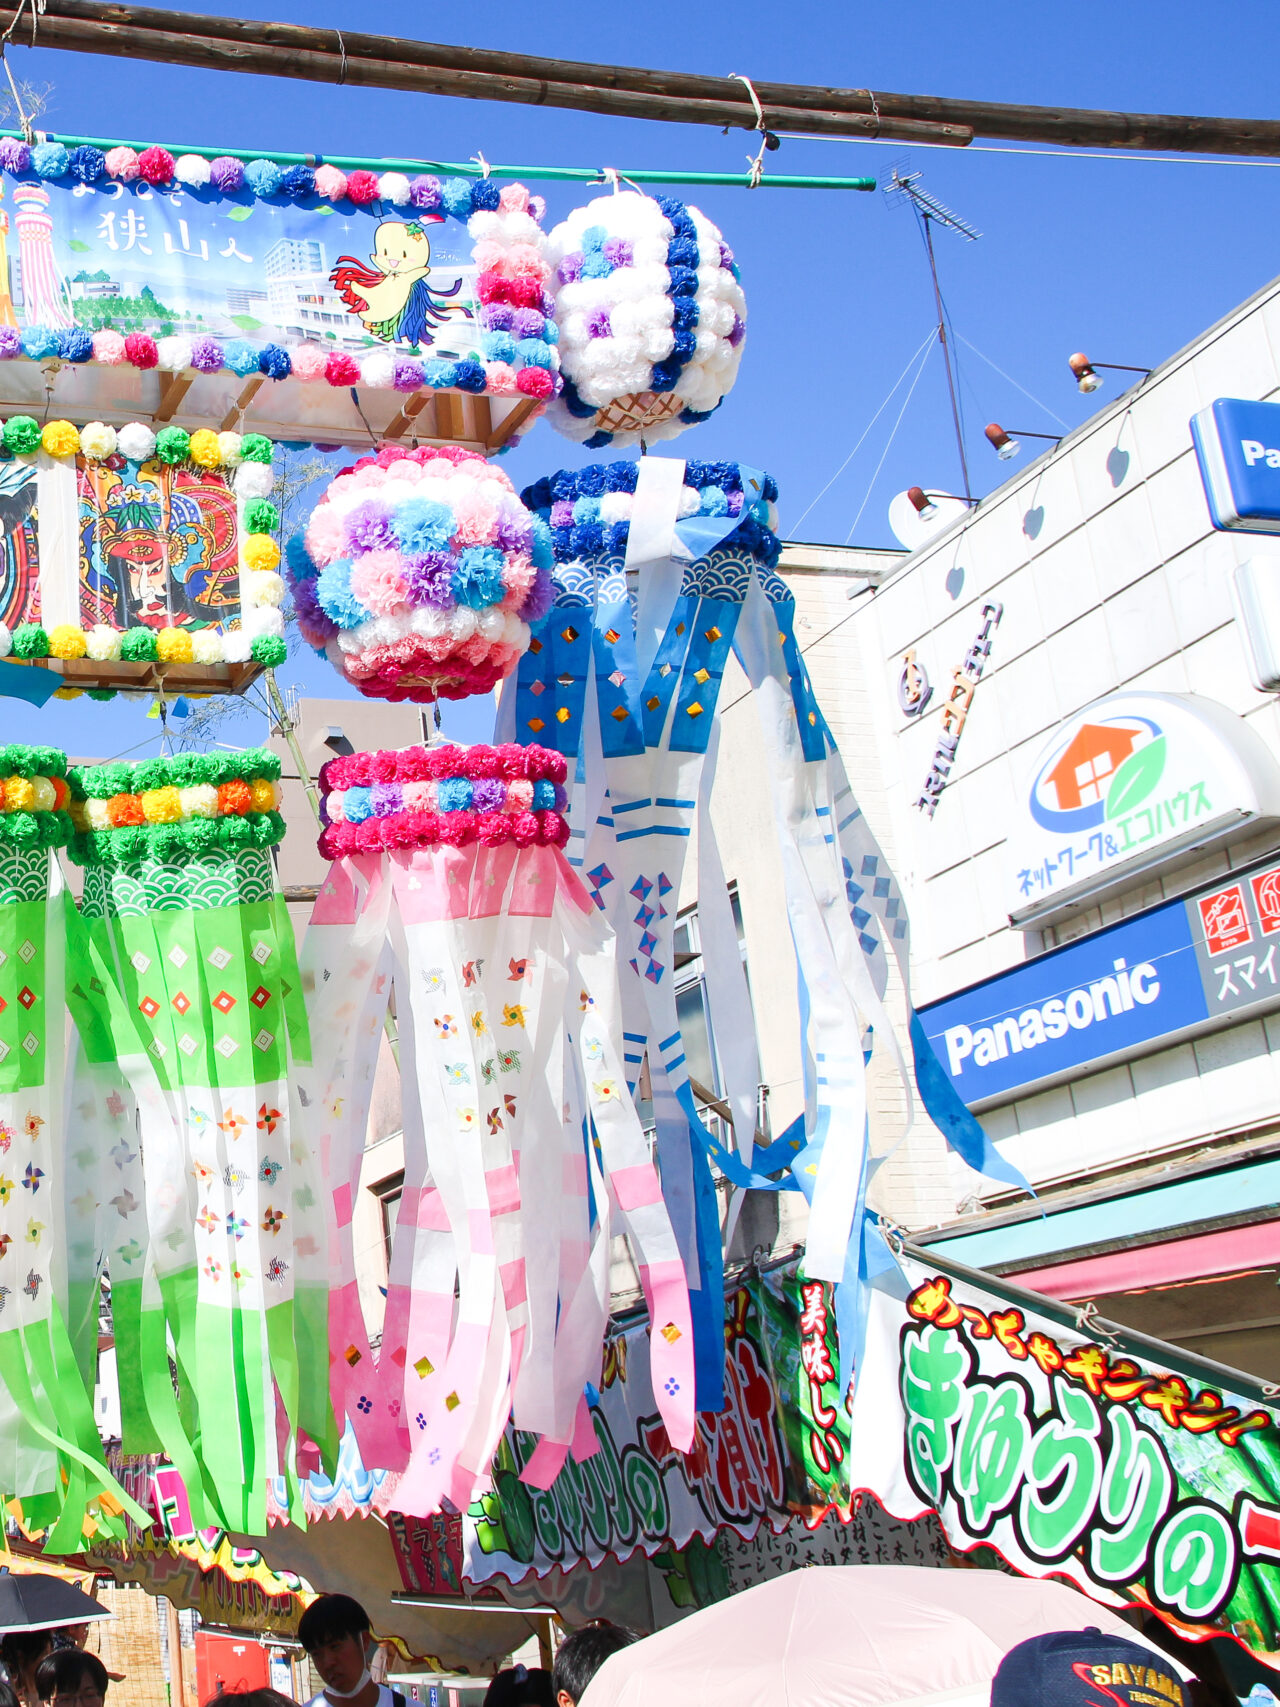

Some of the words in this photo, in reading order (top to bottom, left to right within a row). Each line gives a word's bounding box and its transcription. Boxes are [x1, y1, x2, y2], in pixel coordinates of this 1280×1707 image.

[945, 959, 1160, 1077] Panasonic
[799, 1281, 844, 1473] 美味しい
[1091, 1663, 1184, 1707] SAYAMA
